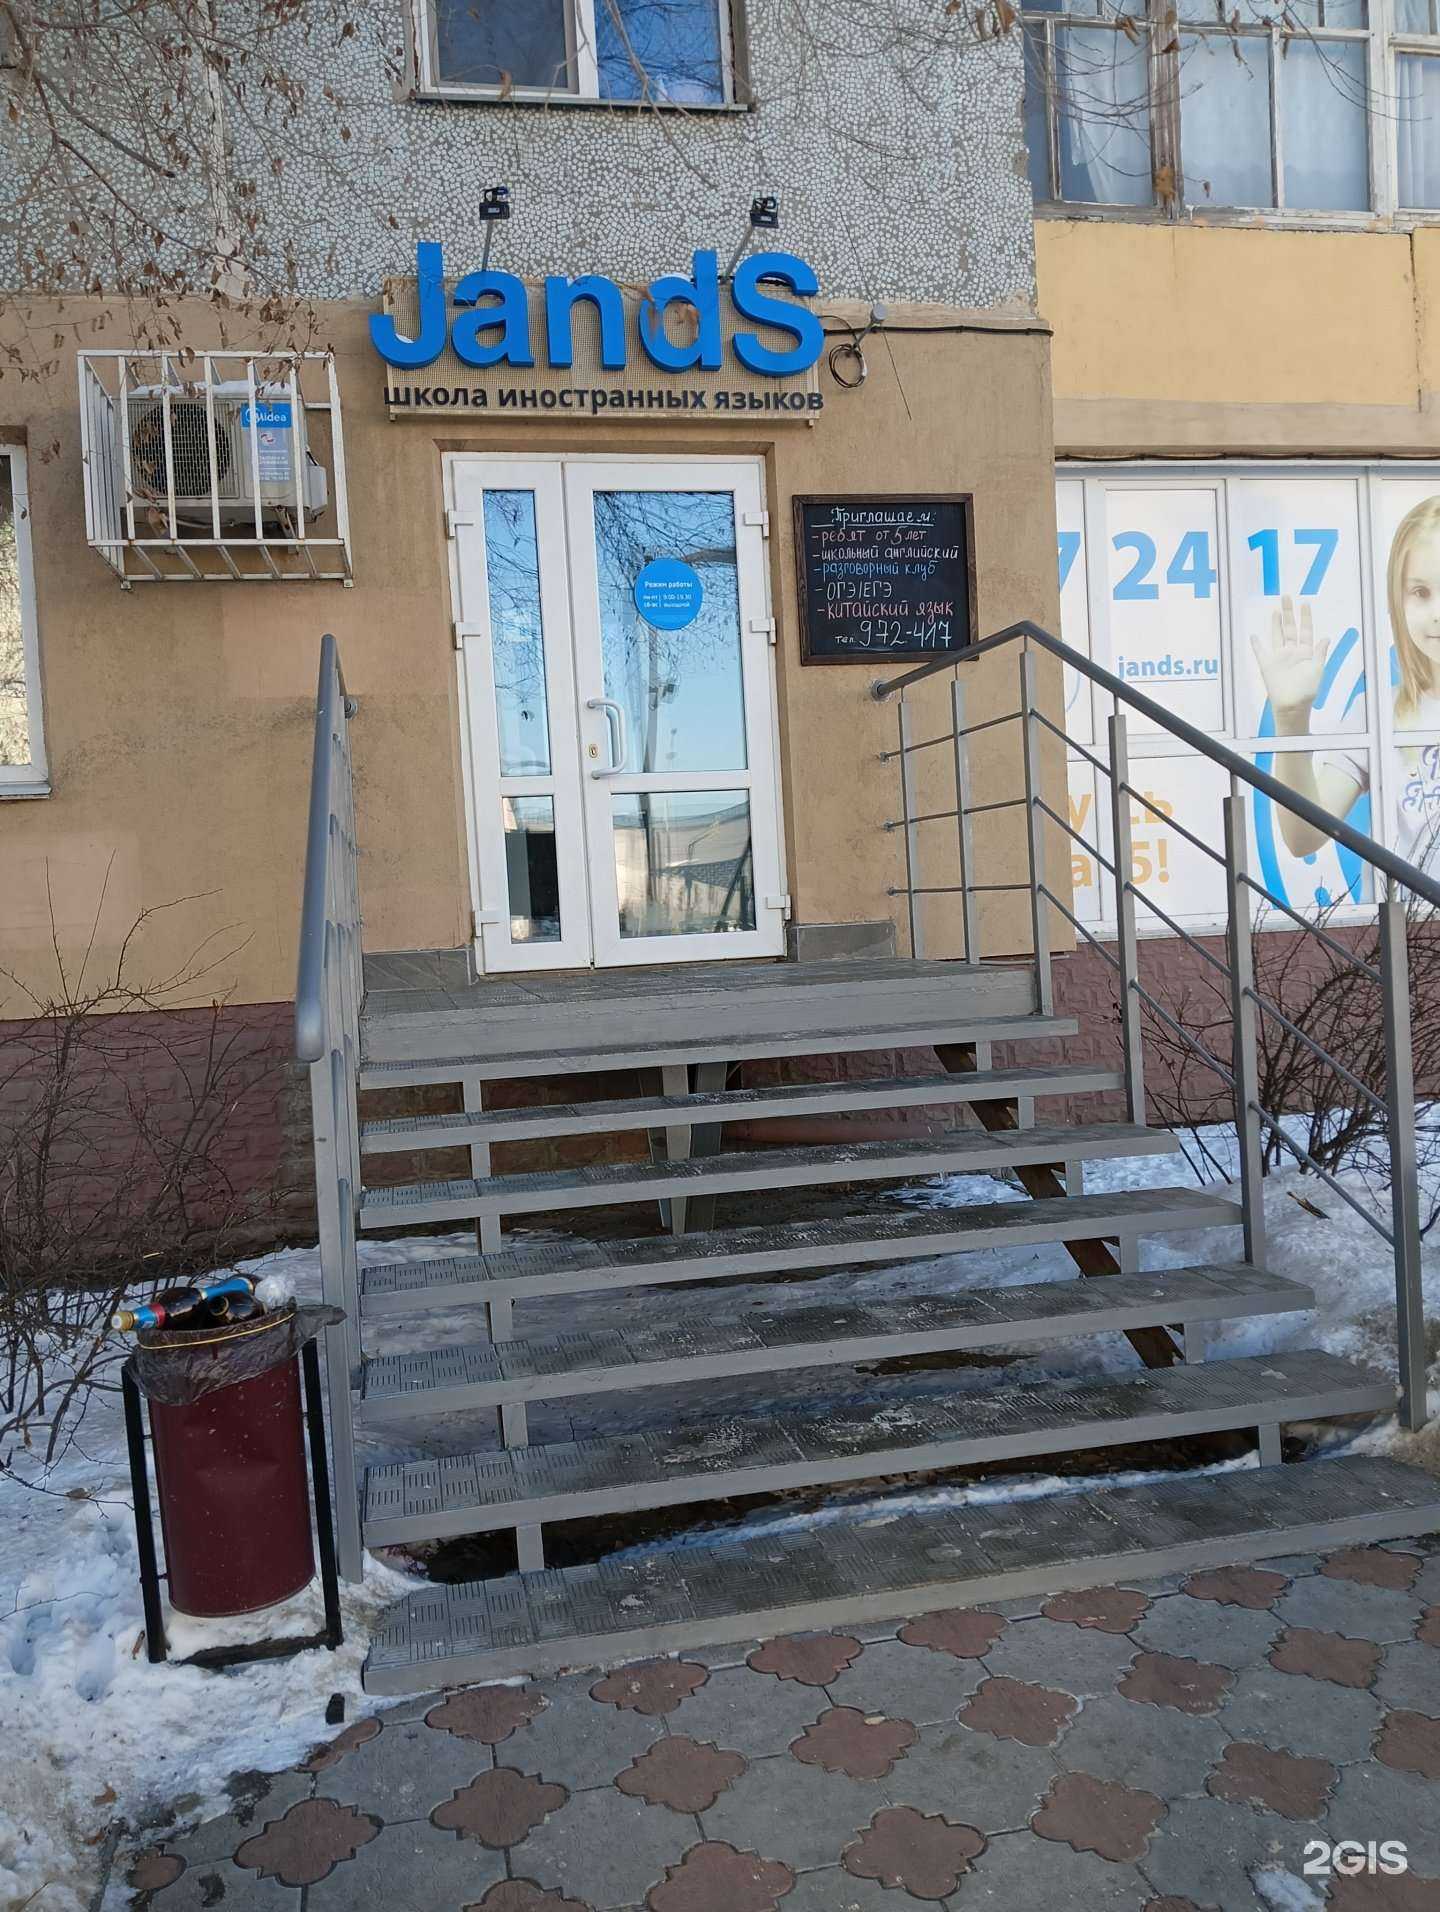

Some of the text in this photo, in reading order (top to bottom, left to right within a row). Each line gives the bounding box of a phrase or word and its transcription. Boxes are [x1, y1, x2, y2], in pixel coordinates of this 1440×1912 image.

[369, 241, 825, 377] JandS
[384, 384, 825, 414] школа иностранных языков
[884, 545, 959, 559] английский
[1111, 530, 1217, 600] 24
[1247, 528, 1339, 596] 17
[905, 560, 938, 581] клуб
[916, 601, 953, 625] язык
[859, 619, 952, 648] 972-417
[1118, 655, 1218, 679] jands.ru
